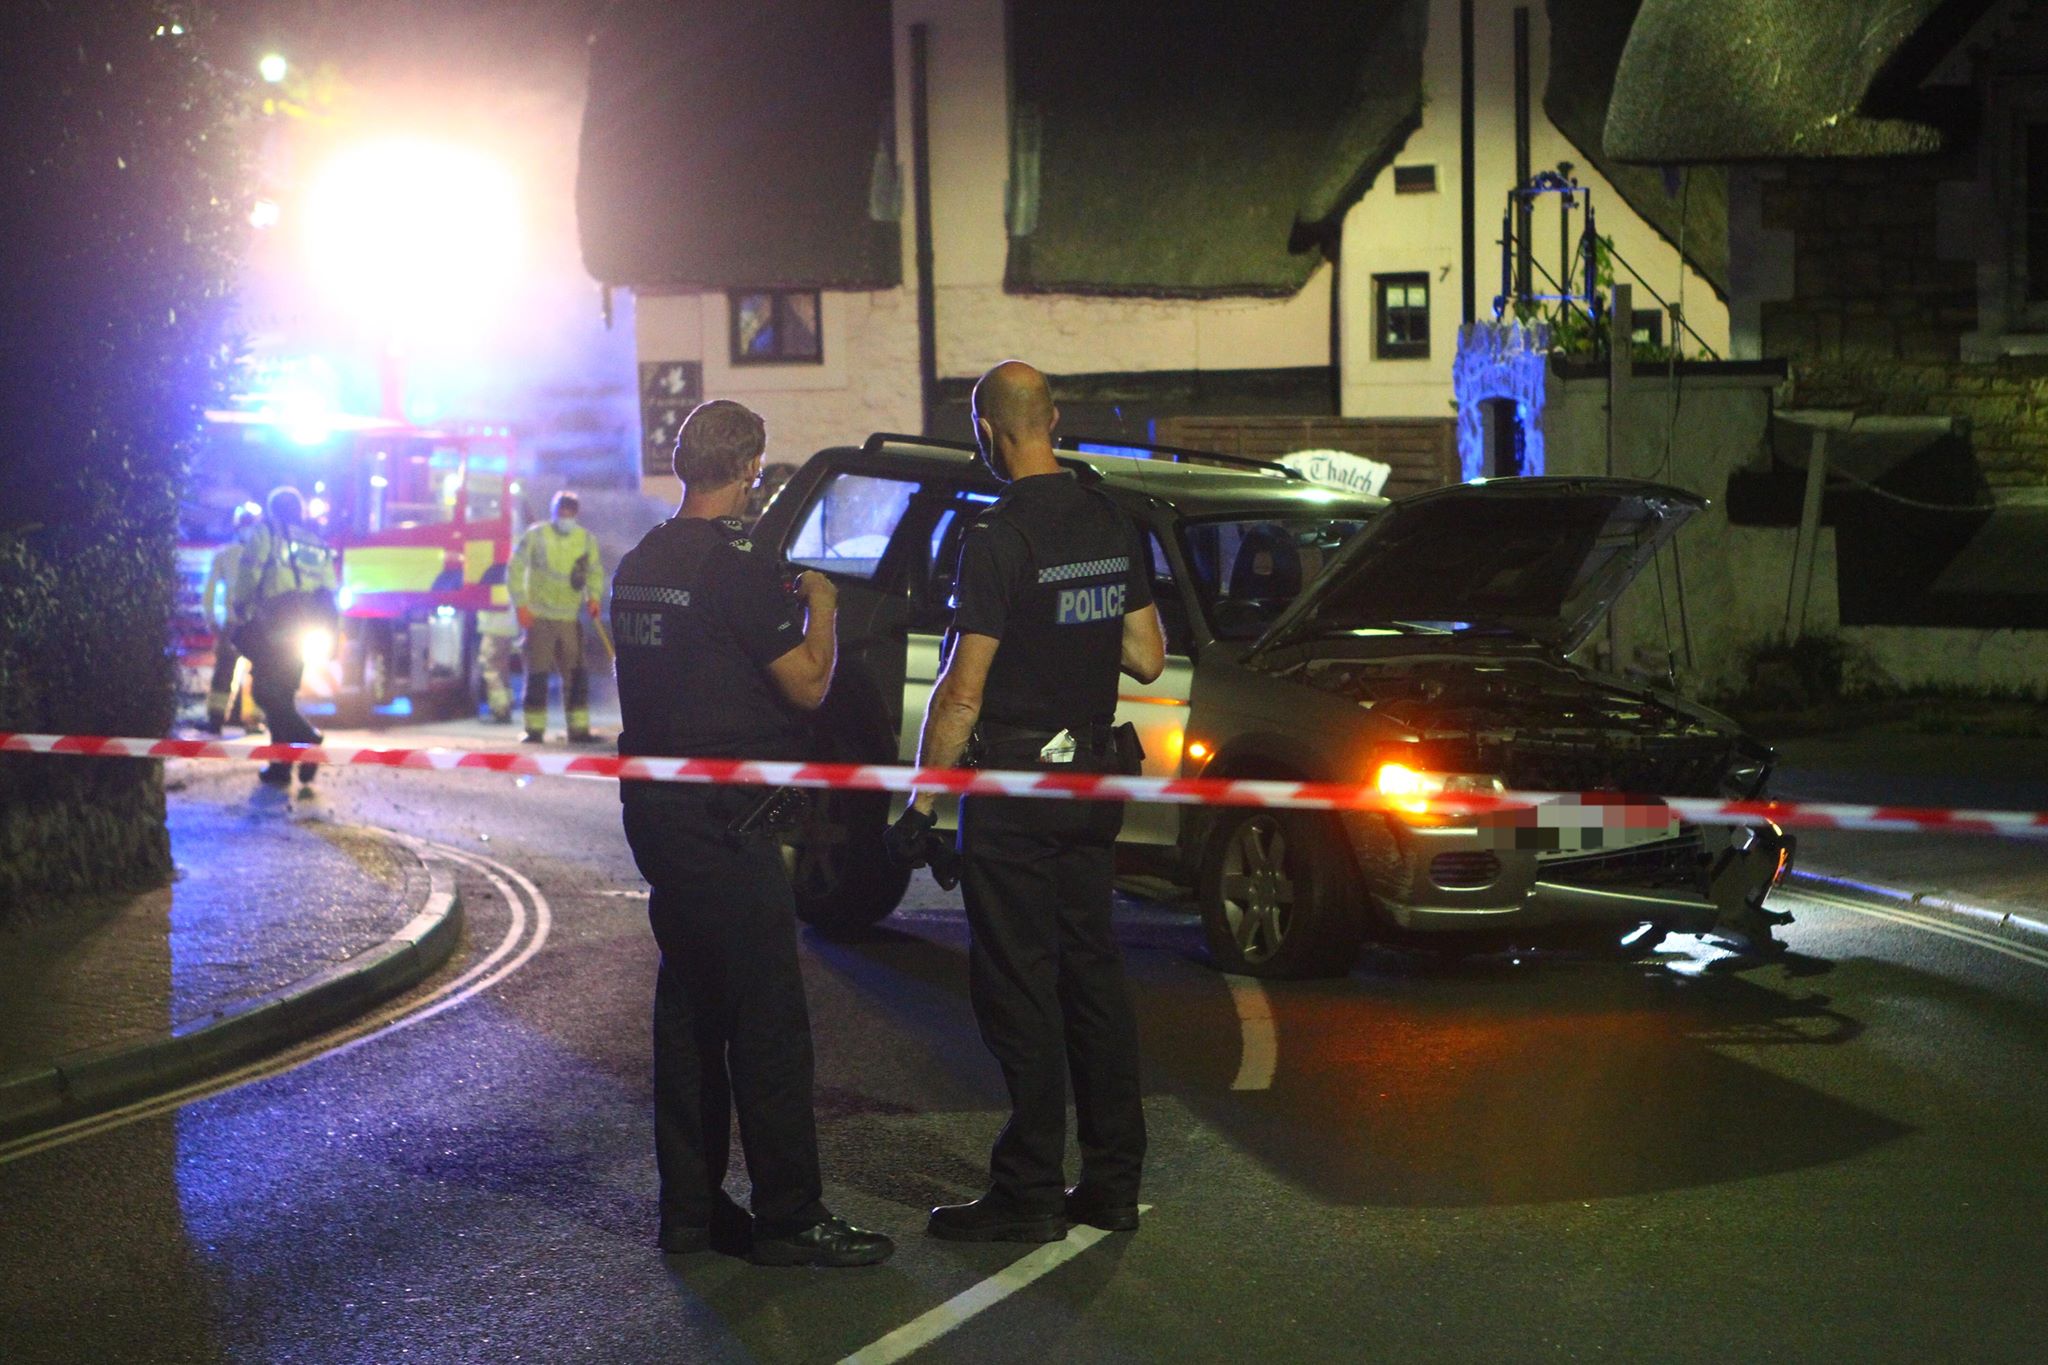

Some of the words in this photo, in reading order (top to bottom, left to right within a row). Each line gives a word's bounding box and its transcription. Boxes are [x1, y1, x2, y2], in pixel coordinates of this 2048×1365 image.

[1310, 456, 1372, 493] Thatch
[1059, 584, 1126, 623] POLICE
[614, 611, 662, 646] OLICE
